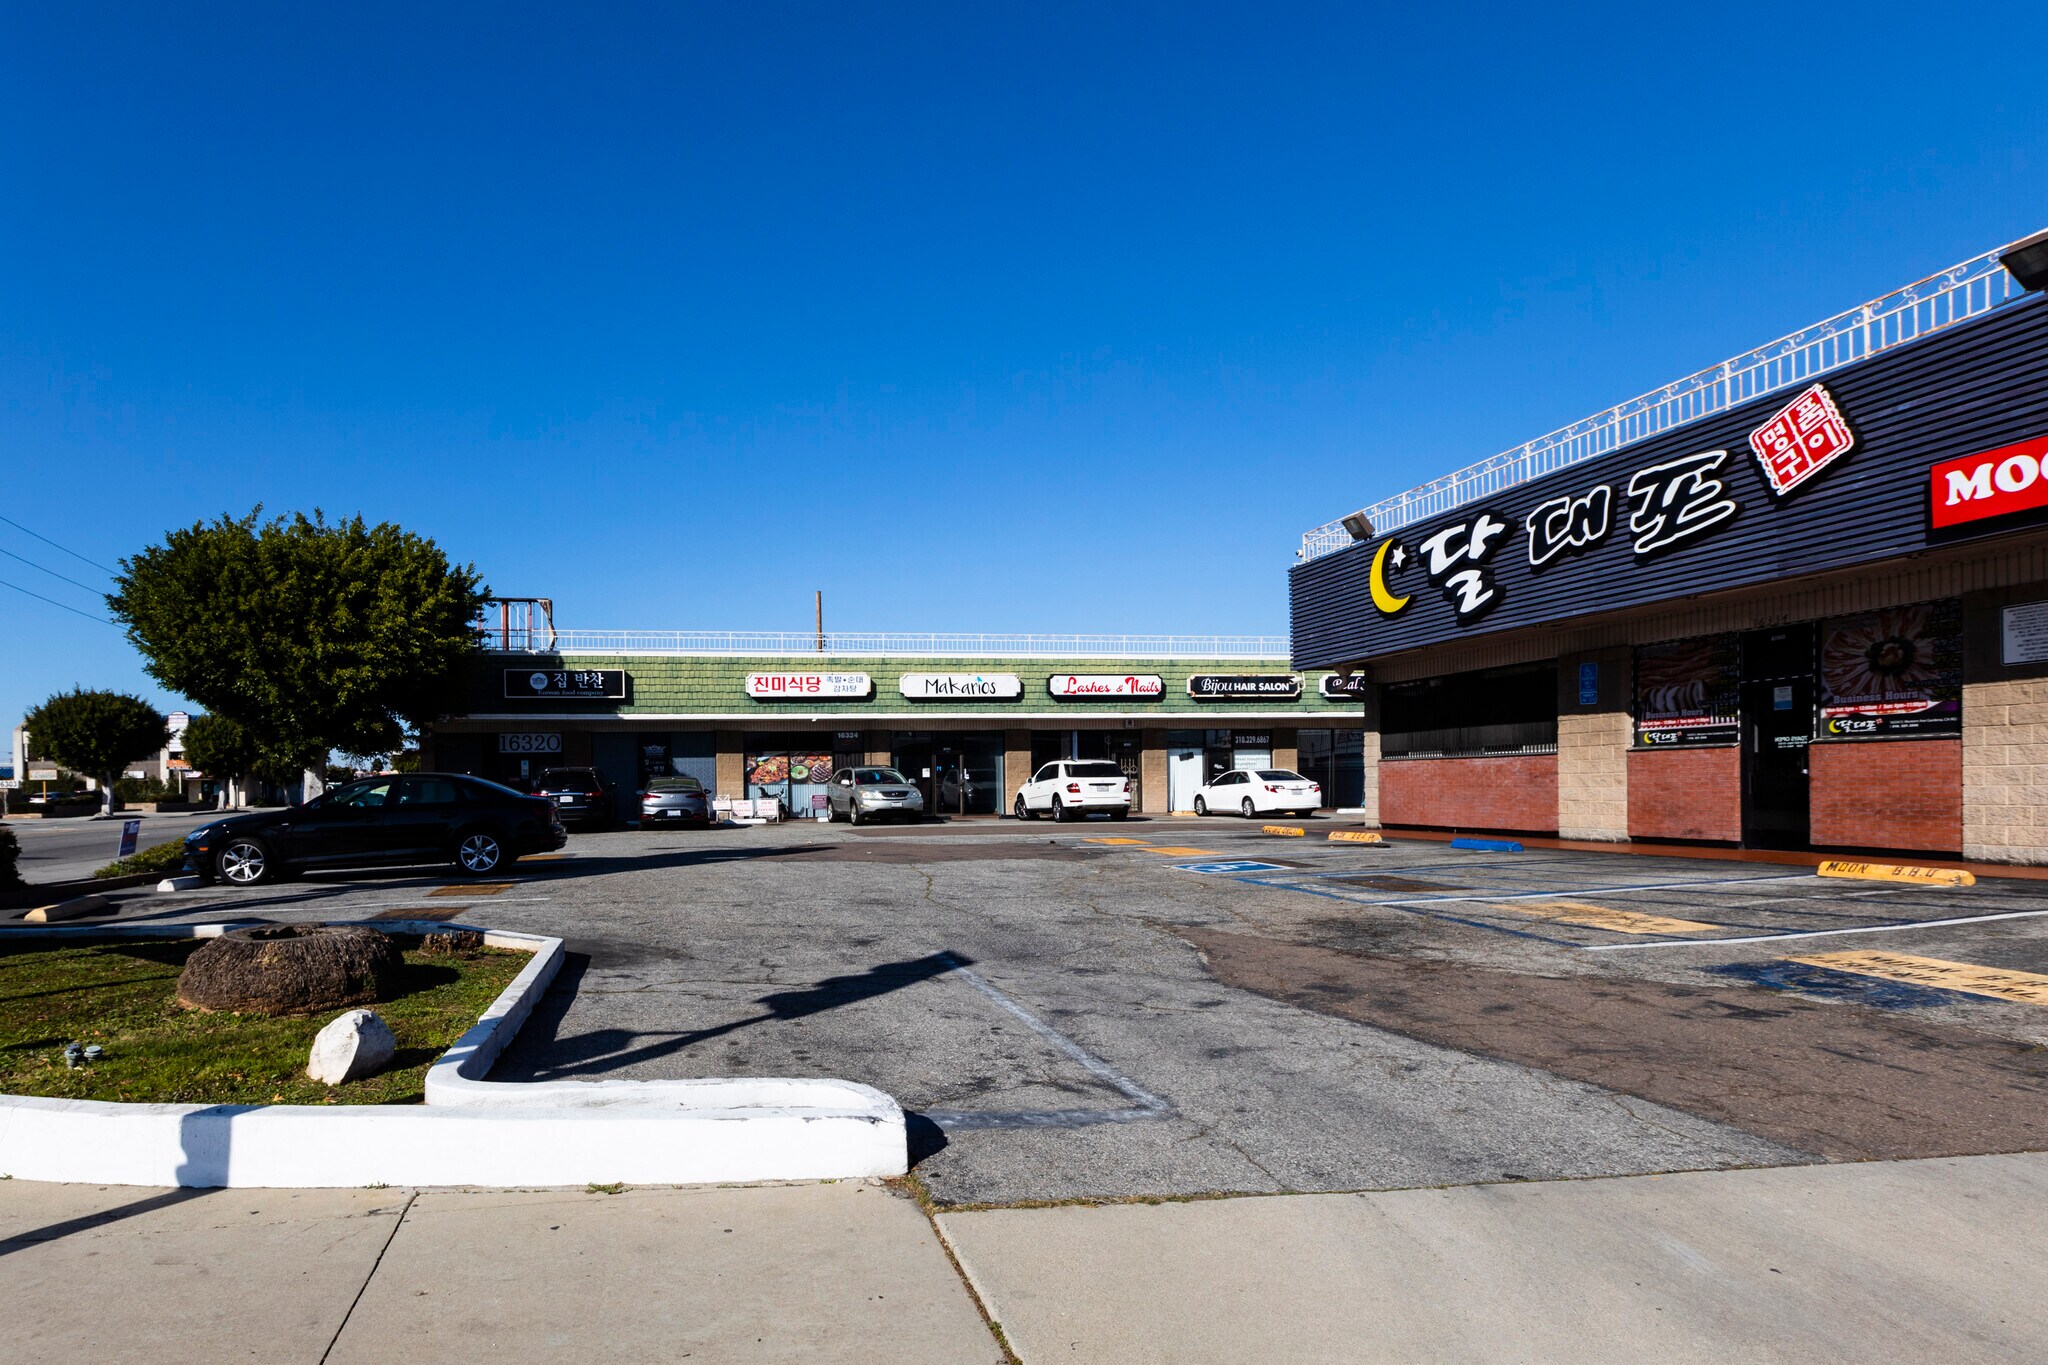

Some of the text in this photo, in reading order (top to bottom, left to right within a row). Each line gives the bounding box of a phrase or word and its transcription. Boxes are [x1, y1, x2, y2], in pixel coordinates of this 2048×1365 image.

[1945, 452, 2048, 506] MO
[553, 672, 605, 689] 집 반찬
[754, 676, 822, 693] 진미식당
[833, 685, 857, 693] 감자탕
[924, 676, 996, 695] Makarios
[1062, 676, 1160, 694] Lashes & Nails
[1201, 677, 1290, 695] Bijou HAIR SALON
[1833, 690, 1919, 704] Business Hours
[1645, 708, 1704, 720] Business Hours
[500, 734, 561, 752] 16320
[837, 732, 859, 740] 16324
[1825, 861, 1870, 874] MOON
